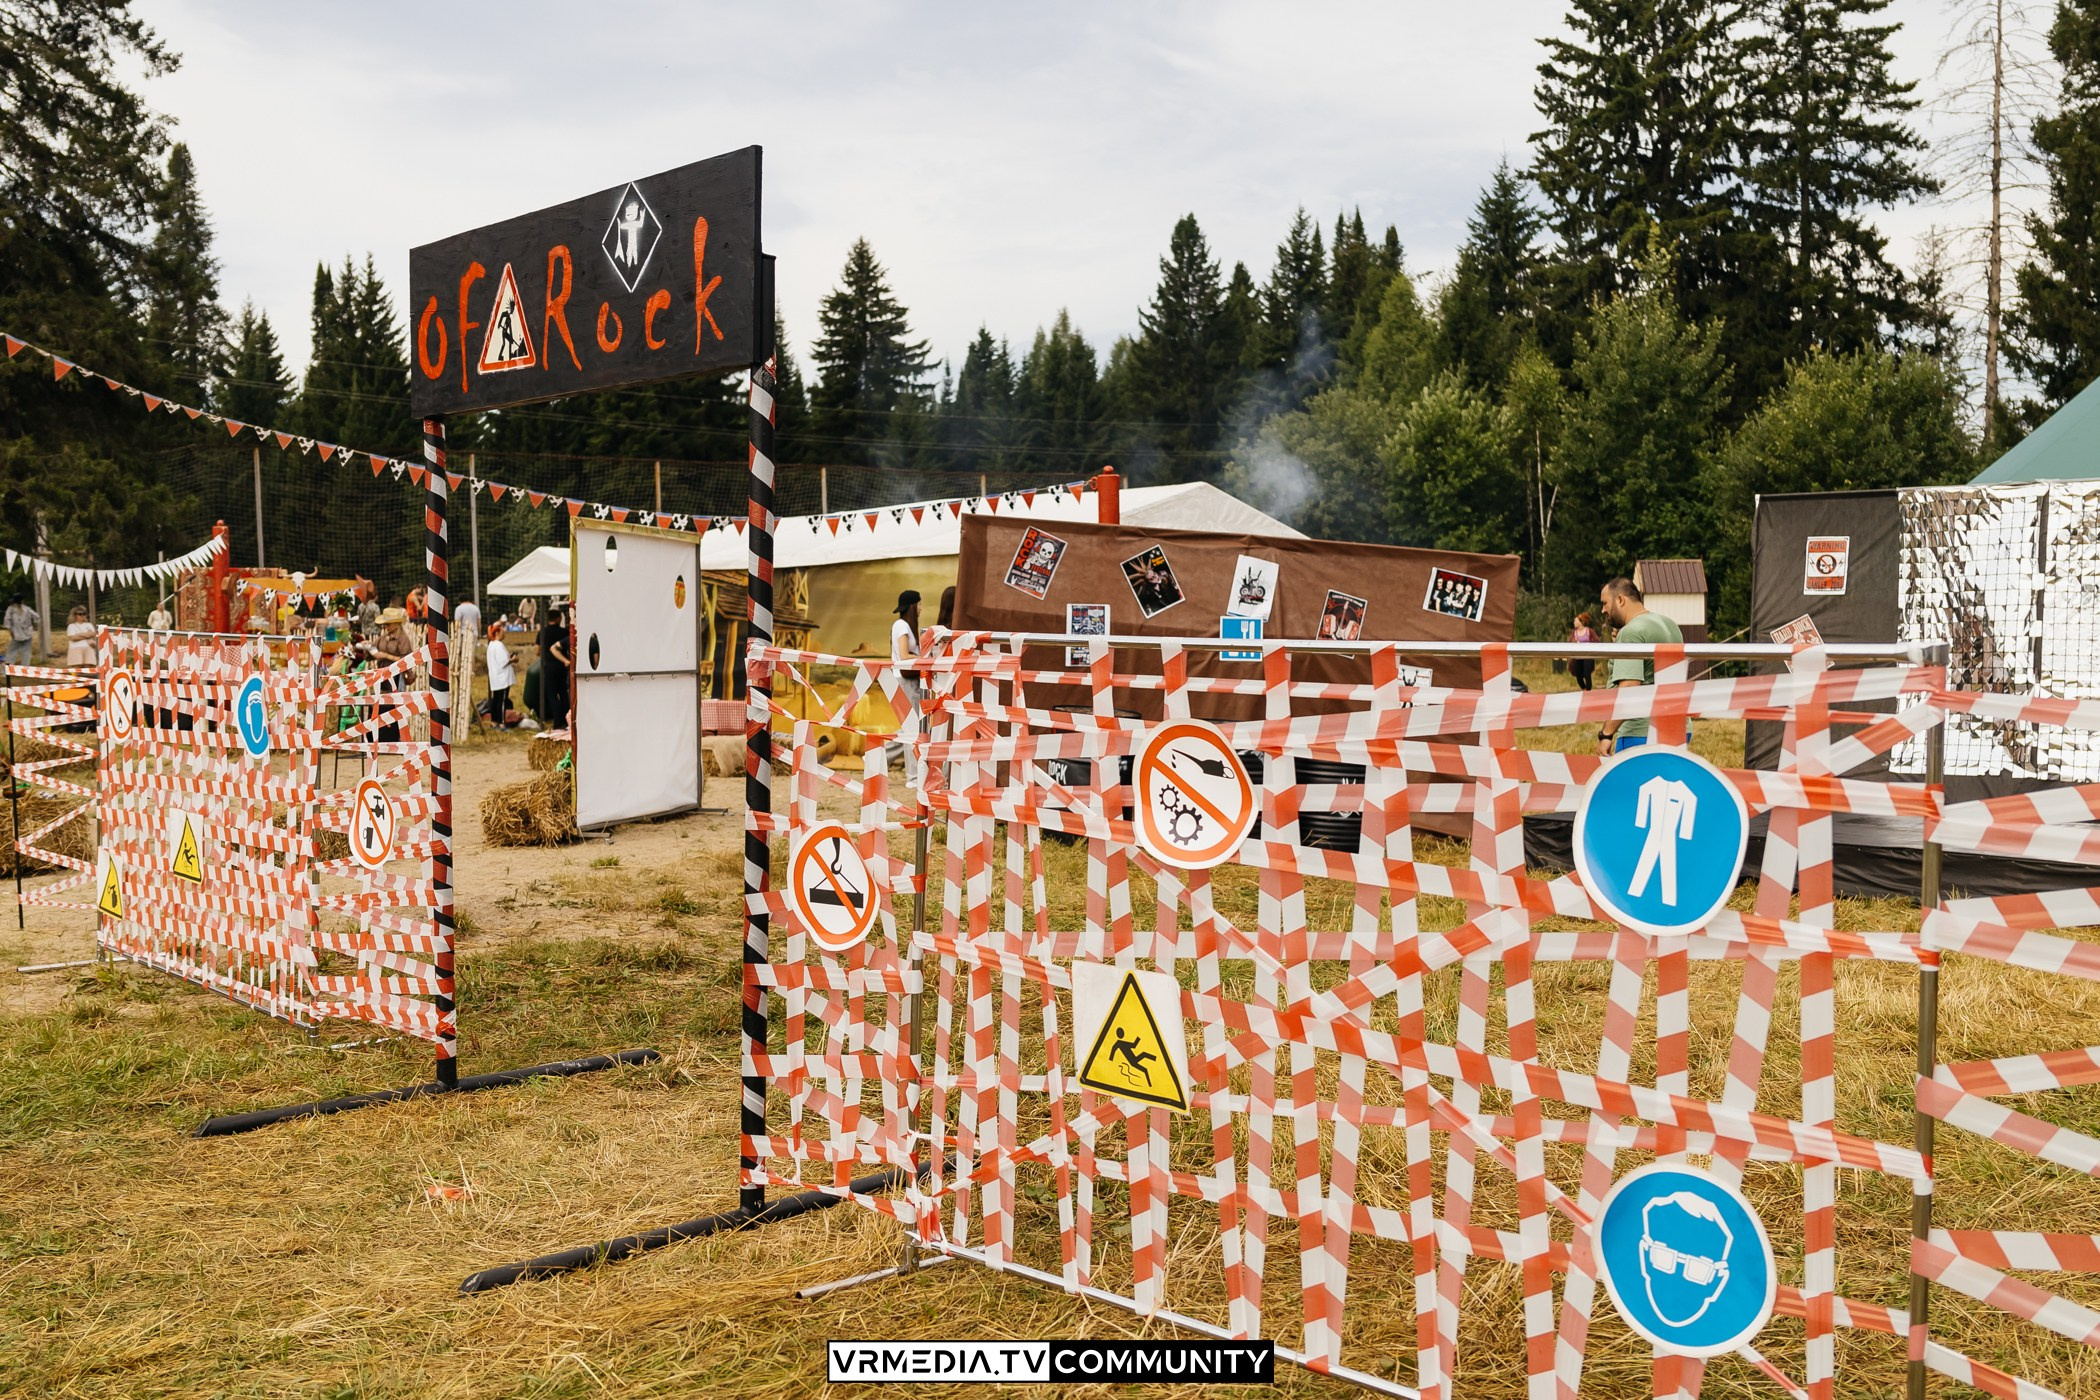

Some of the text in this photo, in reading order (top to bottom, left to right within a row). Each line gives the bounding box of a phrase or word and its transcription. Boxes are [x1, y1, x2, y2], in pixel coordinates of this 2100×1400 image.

[542, 216, 724, 372] Rock
[1015, 528, 1038, 569] ROCK
[1809, 541, 1845, 550] WARNING
